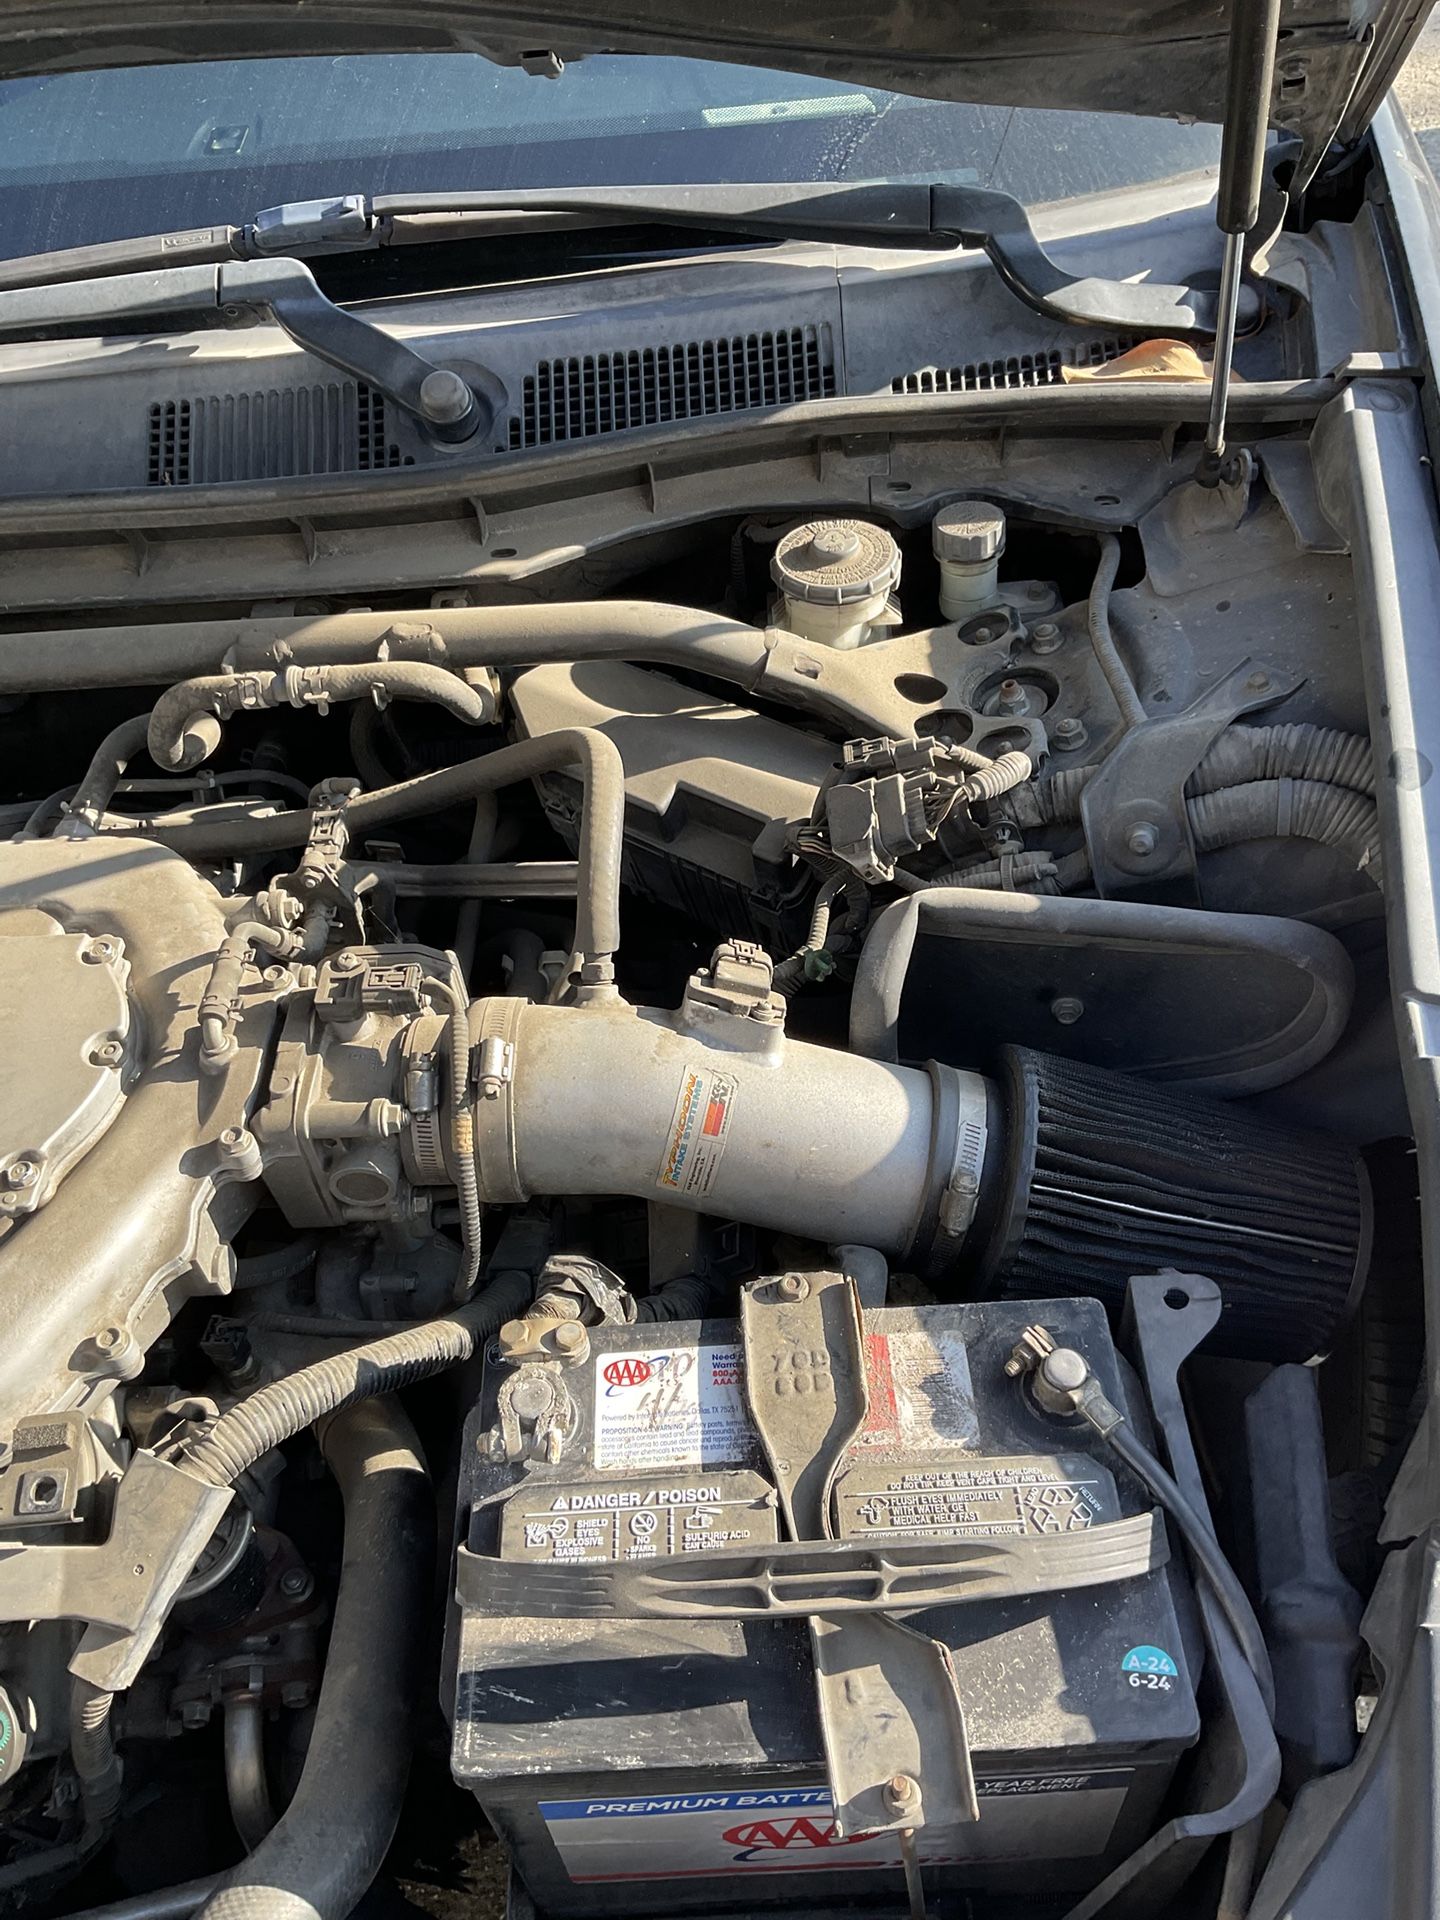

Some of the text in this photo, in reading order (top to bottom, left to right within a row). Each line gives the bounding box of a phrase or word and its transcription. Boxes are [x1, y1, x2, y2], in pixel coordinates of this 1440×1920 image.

[662, 1072, 698, 1187] TYPHOON
[671, 1079, 703, 1182] INTAKE SYSTEMS
[711, 1353, 736, 1361] Need
[603, 1359, 650, 1386] AAA
[712, 1378, 744, 1386] AAA.c
[601, 1413, 627, 1422] Powered
[628, 1413, 636, 1421] by
[601, 1426, 642, 1435] PROPOSITION
[924, 1472, 940, 1481] OUT
[942, 1472, 953, 1480] OF
[955, 1470, 969, 1479] THE
[970, 1469, 994, 1478] REACH
[1008, 1467, 1042, 1476] CHILDREN
[890, 1482, 902, 1490] DO
[903, 1480, 919, 1489] NOT
[957, 1478, 975, 1487] VENT
[1021, 1474, 1037, 1483] AND
[890, 1491, 1004, 1506] FLUSH EYES IMMEDIATELY
[1078, 1485, 1103, 1512] RETURN
[891, 1505, 916, 1516] WITH
[951, 1502, 971, 1512] GET
[575, 1518, 609, 1528] SHIELD
[893, 1511, 982, 1526] MEDICAL HELP FAST
[575, 1527, 601, 1538] EYES
[684, 1529, 751, 1542] SULFURIC ACID
[554, 1536, 605, 1549] EXPLOSIVE
[636, 1535, 651, 1545] NO
[684, 1540, 725, 1550] CAN CAUSE
[554, 1547, 586, 1557] GASES
[1128, 1654, 1171, 1673] A-24
[1128, 1672, 1171, 1691] 6-24
[976, 1782, 1087, 1795] EPLACEMENT
[984, 1775, 1092, 1789] YEAR FREE
[586, 1791, 833, 1816] PREMIUM BATTE
